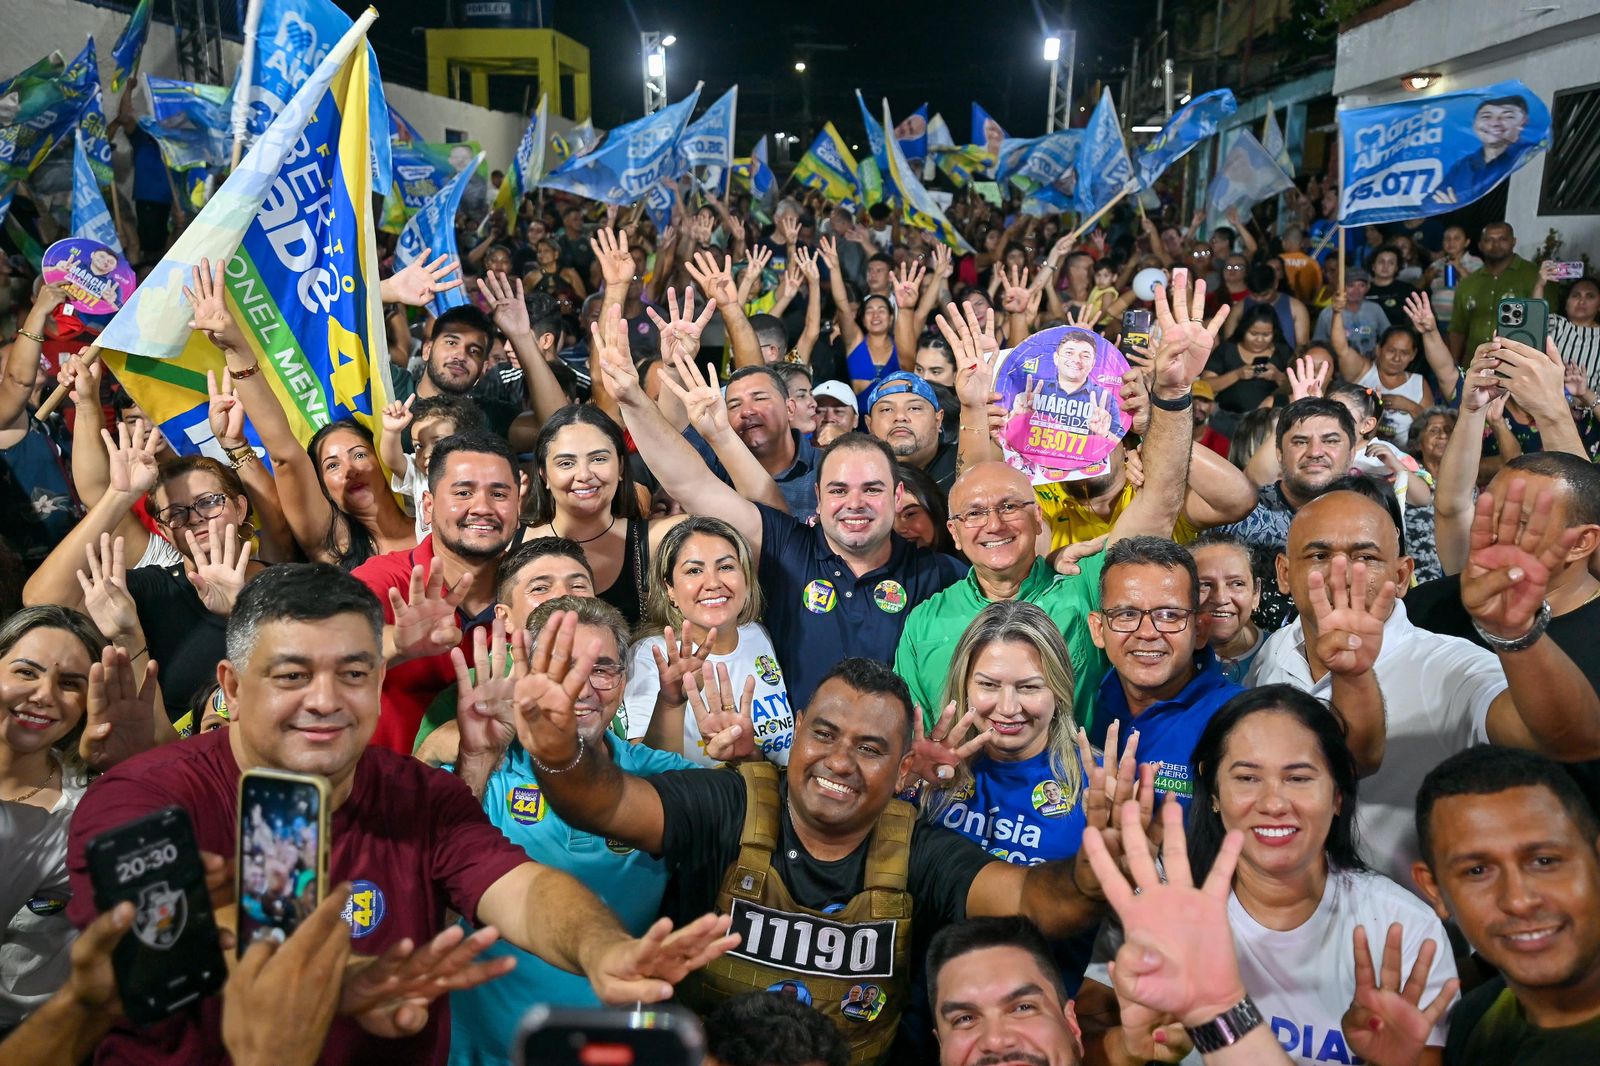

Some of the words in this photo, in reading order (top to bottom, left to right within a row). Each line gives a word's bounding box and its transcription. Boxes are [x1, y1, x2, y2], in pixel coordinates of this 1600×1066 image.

[1031, 410, 1089, 429] ALMEIDA
[1033, 393, 1093, 420] MÁRCIO
[513, 799, 537, 814] 44
[943, 802, 1041, 849] Onísia
[116, 844, 178, 884] 20:30
[353, 889, 372, 926] 44
[745, 911, 878, 972] 11190
